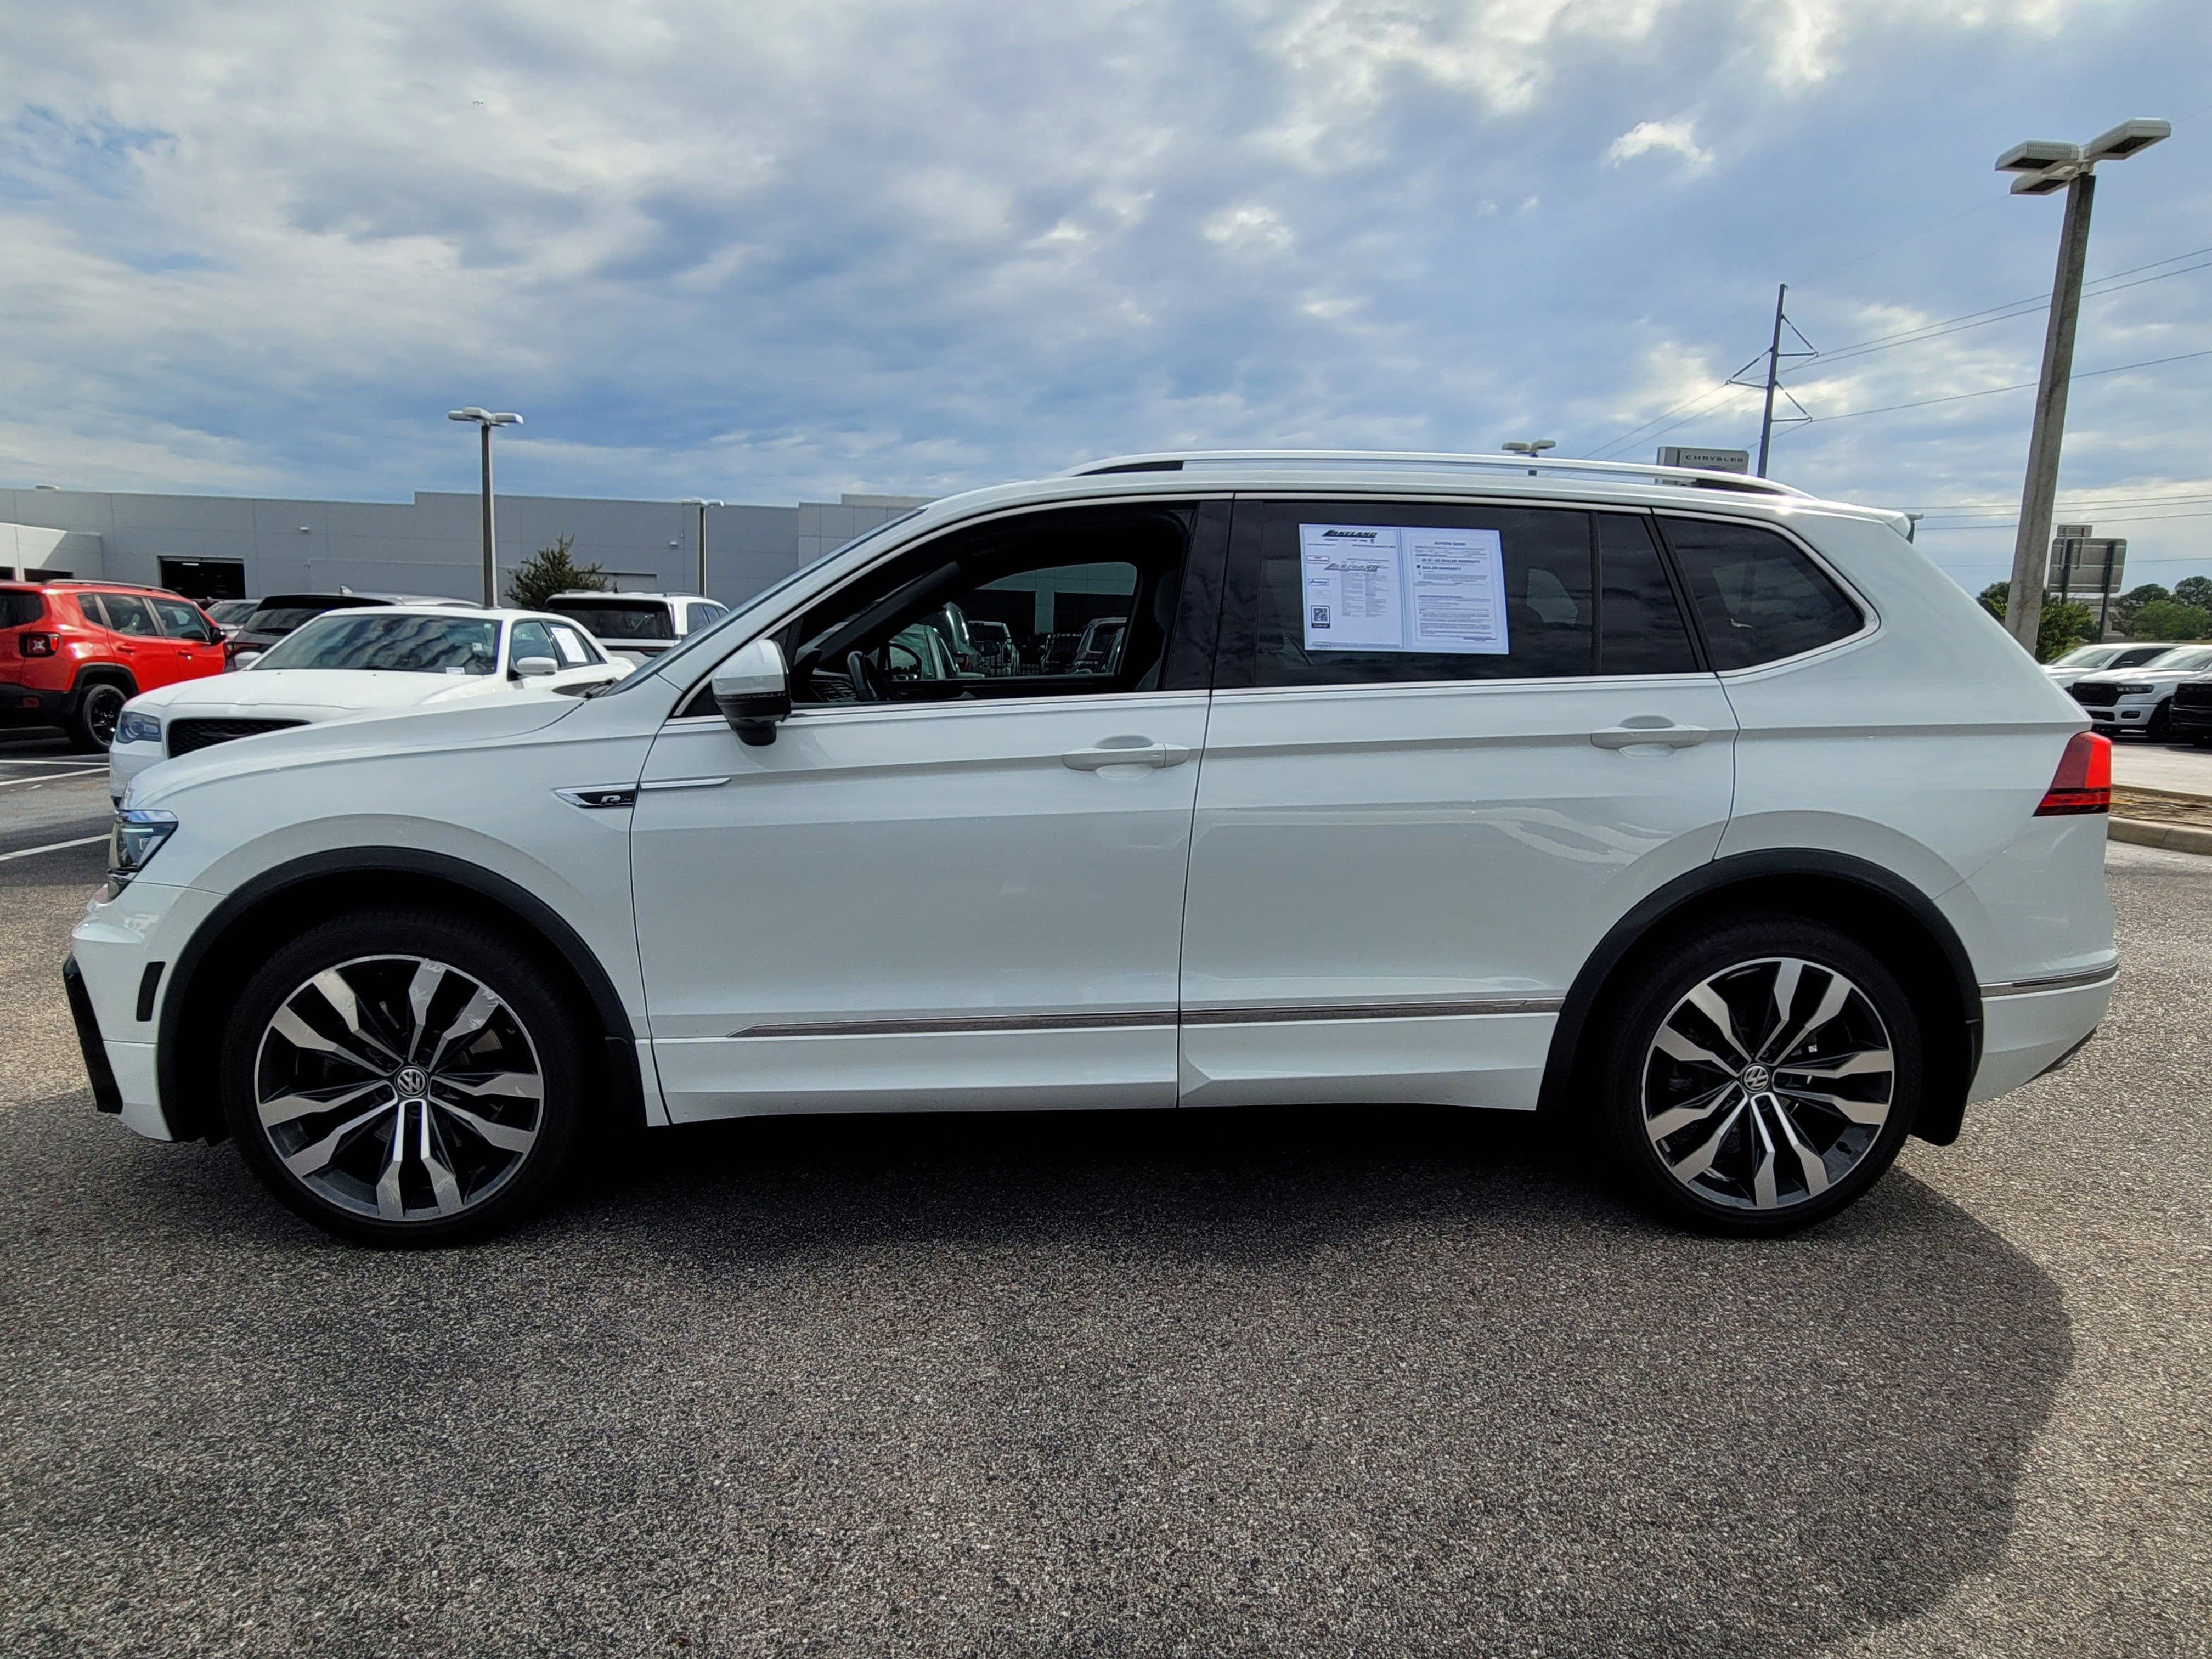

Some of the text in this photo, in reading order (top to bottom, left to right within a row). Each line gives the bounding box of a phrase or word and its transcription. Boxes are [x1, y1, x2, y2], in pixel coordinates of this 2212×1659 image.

[1685, 454, 1743, 463] CHRYSLER
[1321, 529, 1378, 538] LAKELAND
[601, 795, 621, 805] R
[397, 1069, 426, 1095] VW
